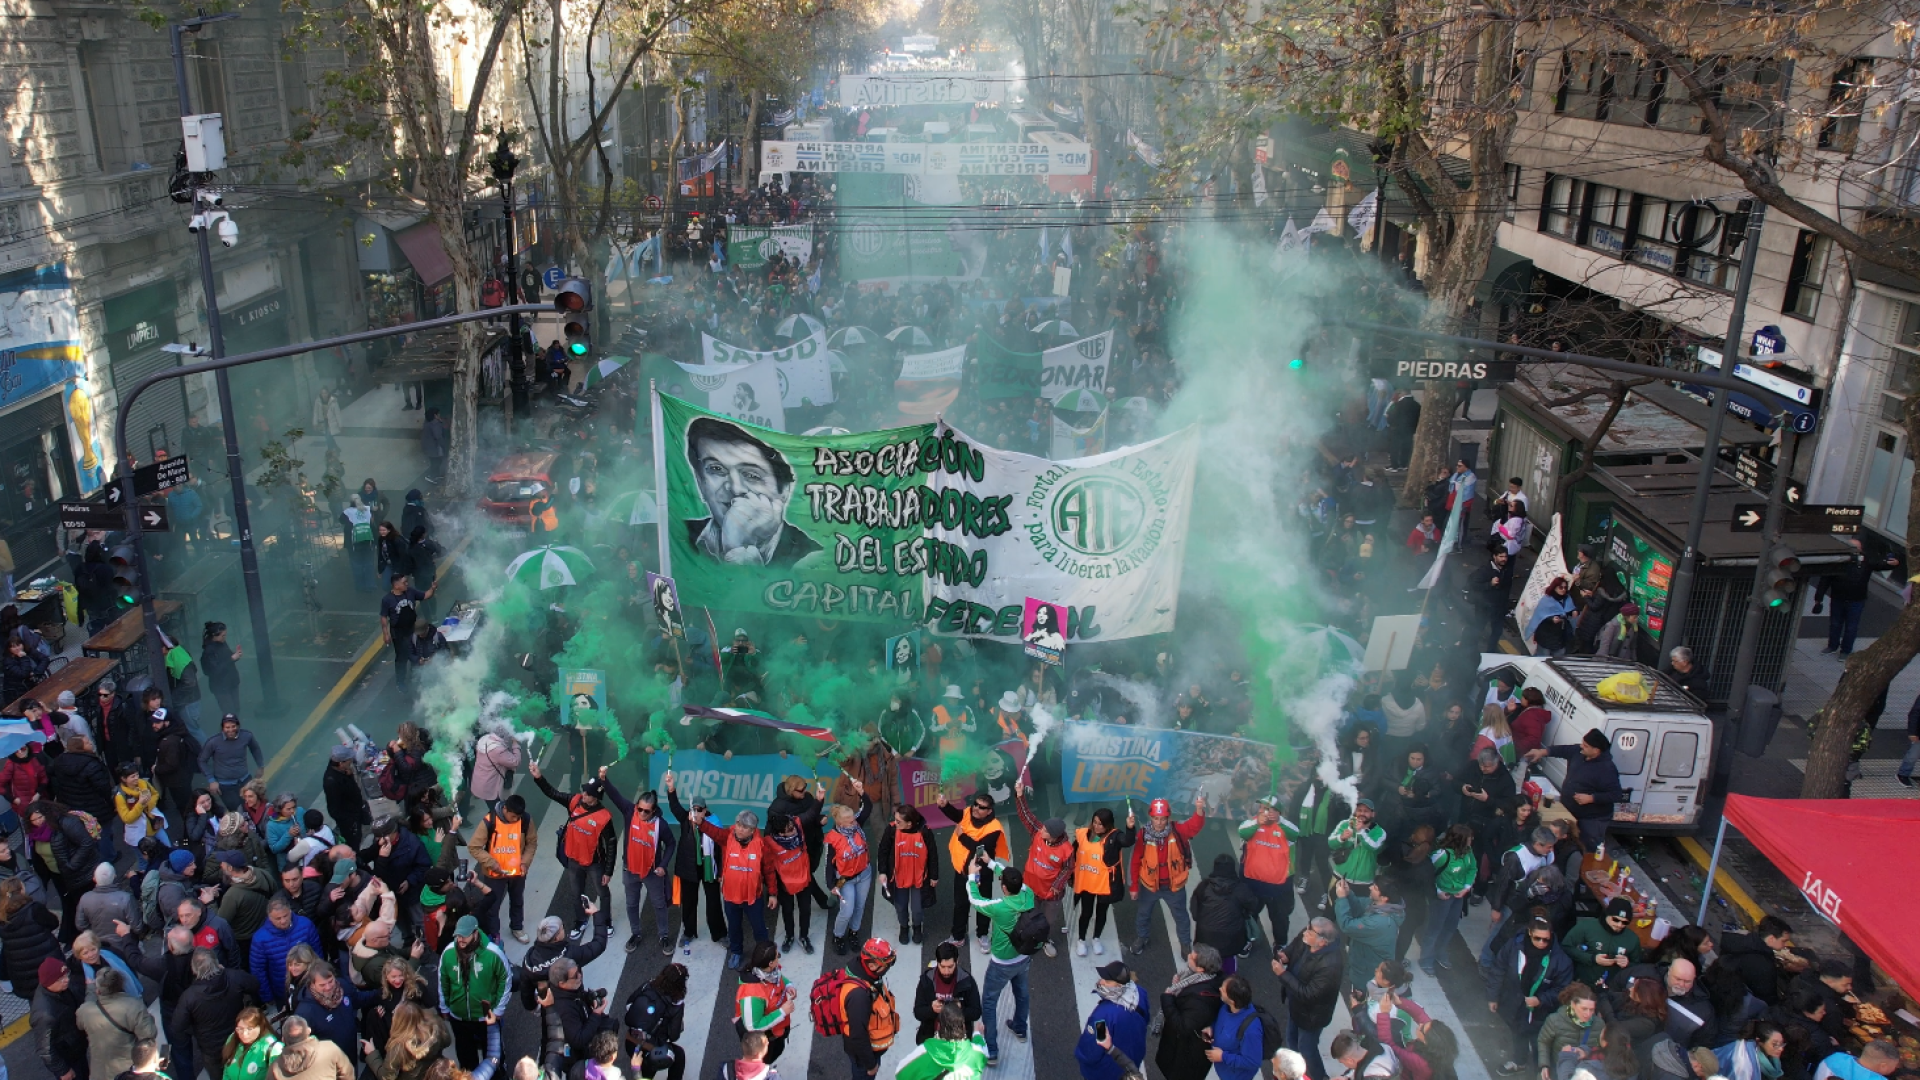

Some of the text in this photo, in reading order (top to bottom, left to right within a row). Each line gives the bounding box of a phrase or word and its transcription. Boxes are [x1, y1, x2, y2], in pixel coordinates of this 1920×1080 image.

[550, 270, 559, 282] E
[249, 301, 279, 321] KIOSCO
[712, 338, 817, 363] SAUD
[1756, 335, 1776, 347] WHAT
[981, 363, 1104, 389] SEDRONAR
[1396, 361, 1487, 379] PIEDRAS
[1729, 401, 1752, 418] TICKETS
[159, 459, 185, 471] Avenida
[813, 430, 985, 482] ASOCIACIÓN
[157, 467, 186, 481] De Mayo
[1129, 458, 1170, 507] Estado
[62, 504, 90, 512] Piedras
[805, 482, 1013, 538] TRABAJADORES
[1058, 480, 1136, 550] ATE
[1825, 507, 1861, 516] Piedras
[835, 532, 988, 588] DEL ESTADO
[1023, 519, 1166, 580] para liberar la Nación
[763, 580, 1101, 640] CAPITAL FEDEAL
[1545, 685, 1577, 720] MINI FLETE
[1075, 736, 1161, 761] CRISTINA
[1621, 736, 1635, 748] 110
[659, 770, 775, 800] CRISTINA
[1071, 761, 1155, 793] LIBRE
